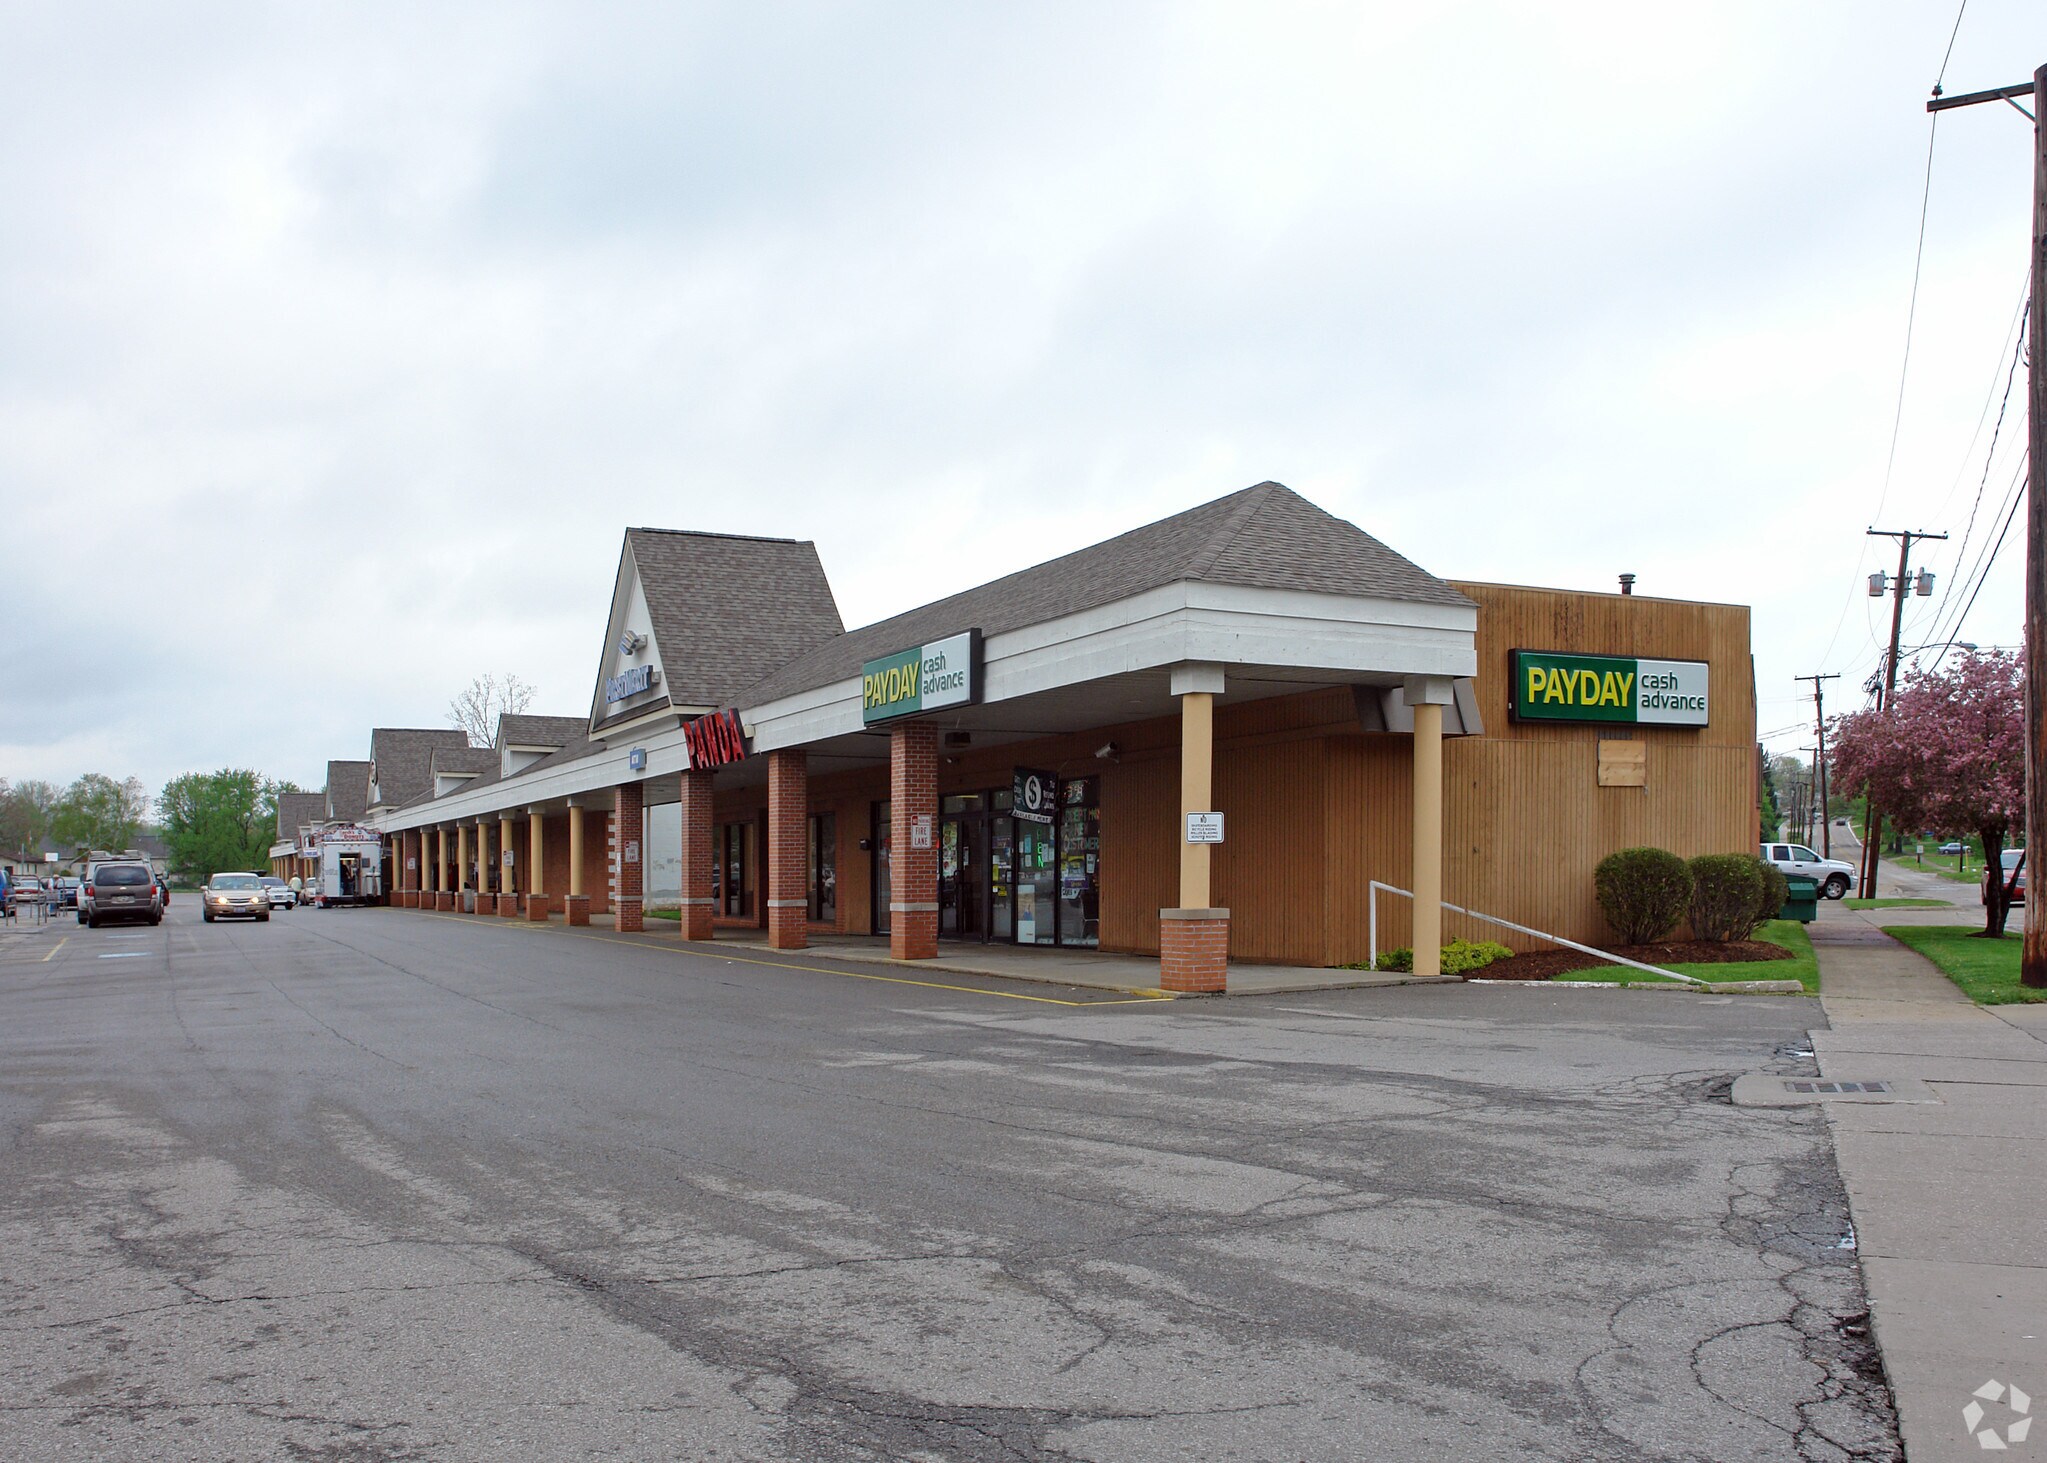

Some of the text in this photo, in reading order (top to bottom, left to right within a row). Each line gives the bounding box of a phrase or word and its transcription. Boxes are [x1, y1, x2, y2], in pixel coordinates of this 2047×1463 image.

[923, 651, 946, 674] cash
[864, 661, 920, 709] PAYDAY
[923, 670, 964, 695] advance
[1527, 666, 1635, 708] PAYDAY
[1641, 671, 1678, 691] cash
[1641, 691, 1705, 711] advance
[682, 708, 745, 771] PANDA
[914, 837, 927, 845] LANE
[915, 827, 926, 835] FIRE
